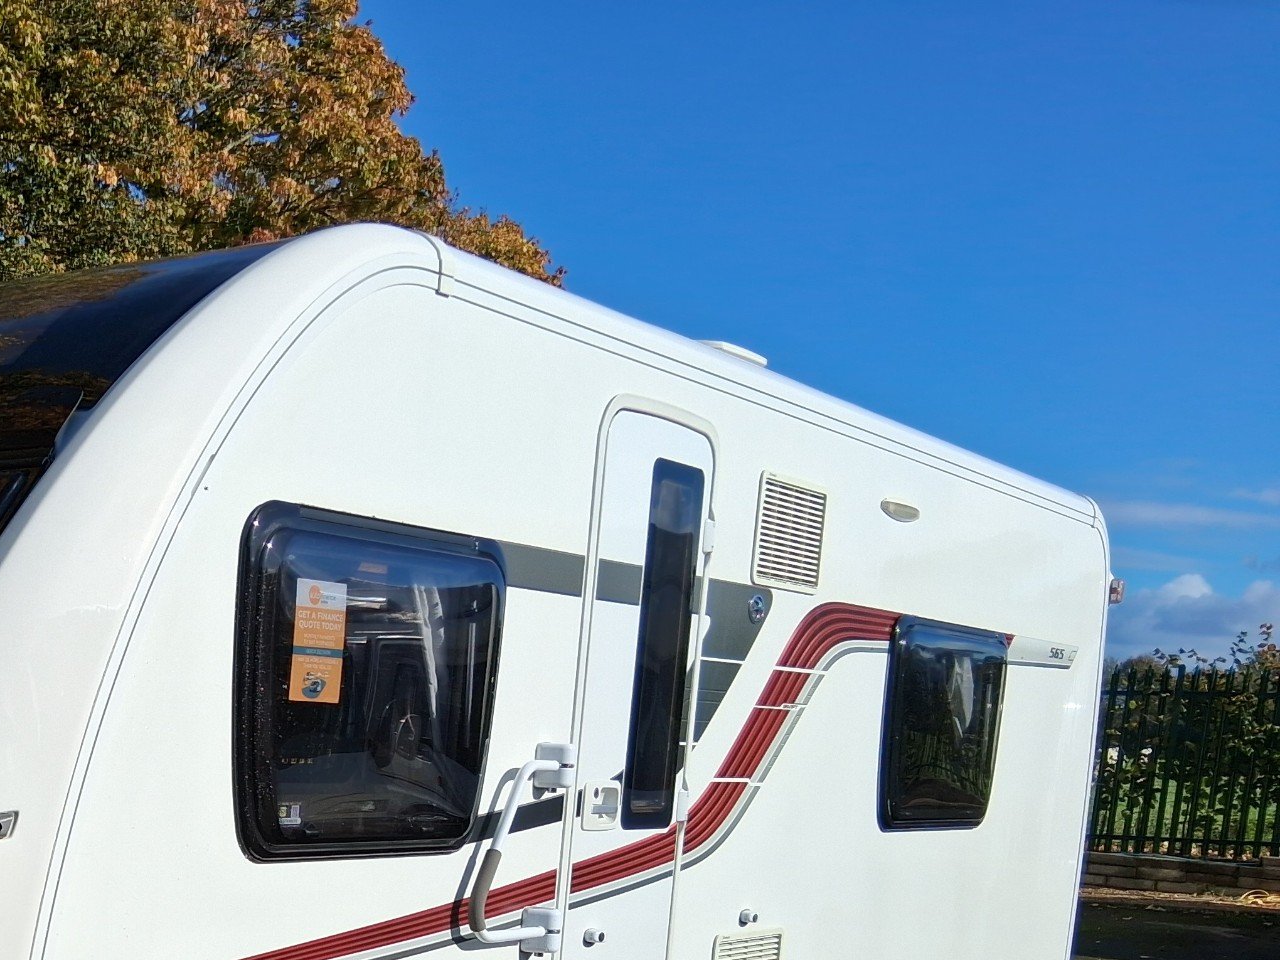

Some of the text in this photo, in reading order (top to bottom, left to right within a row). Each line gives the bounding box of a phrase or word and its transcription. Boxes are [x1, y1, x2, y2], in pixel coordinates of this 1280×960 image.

[298, 610, 343, 622] GET A FINANCE
[299, 620, 342, 631] QUOTE TODAY
[1049, 647, 1065, 660] 565
